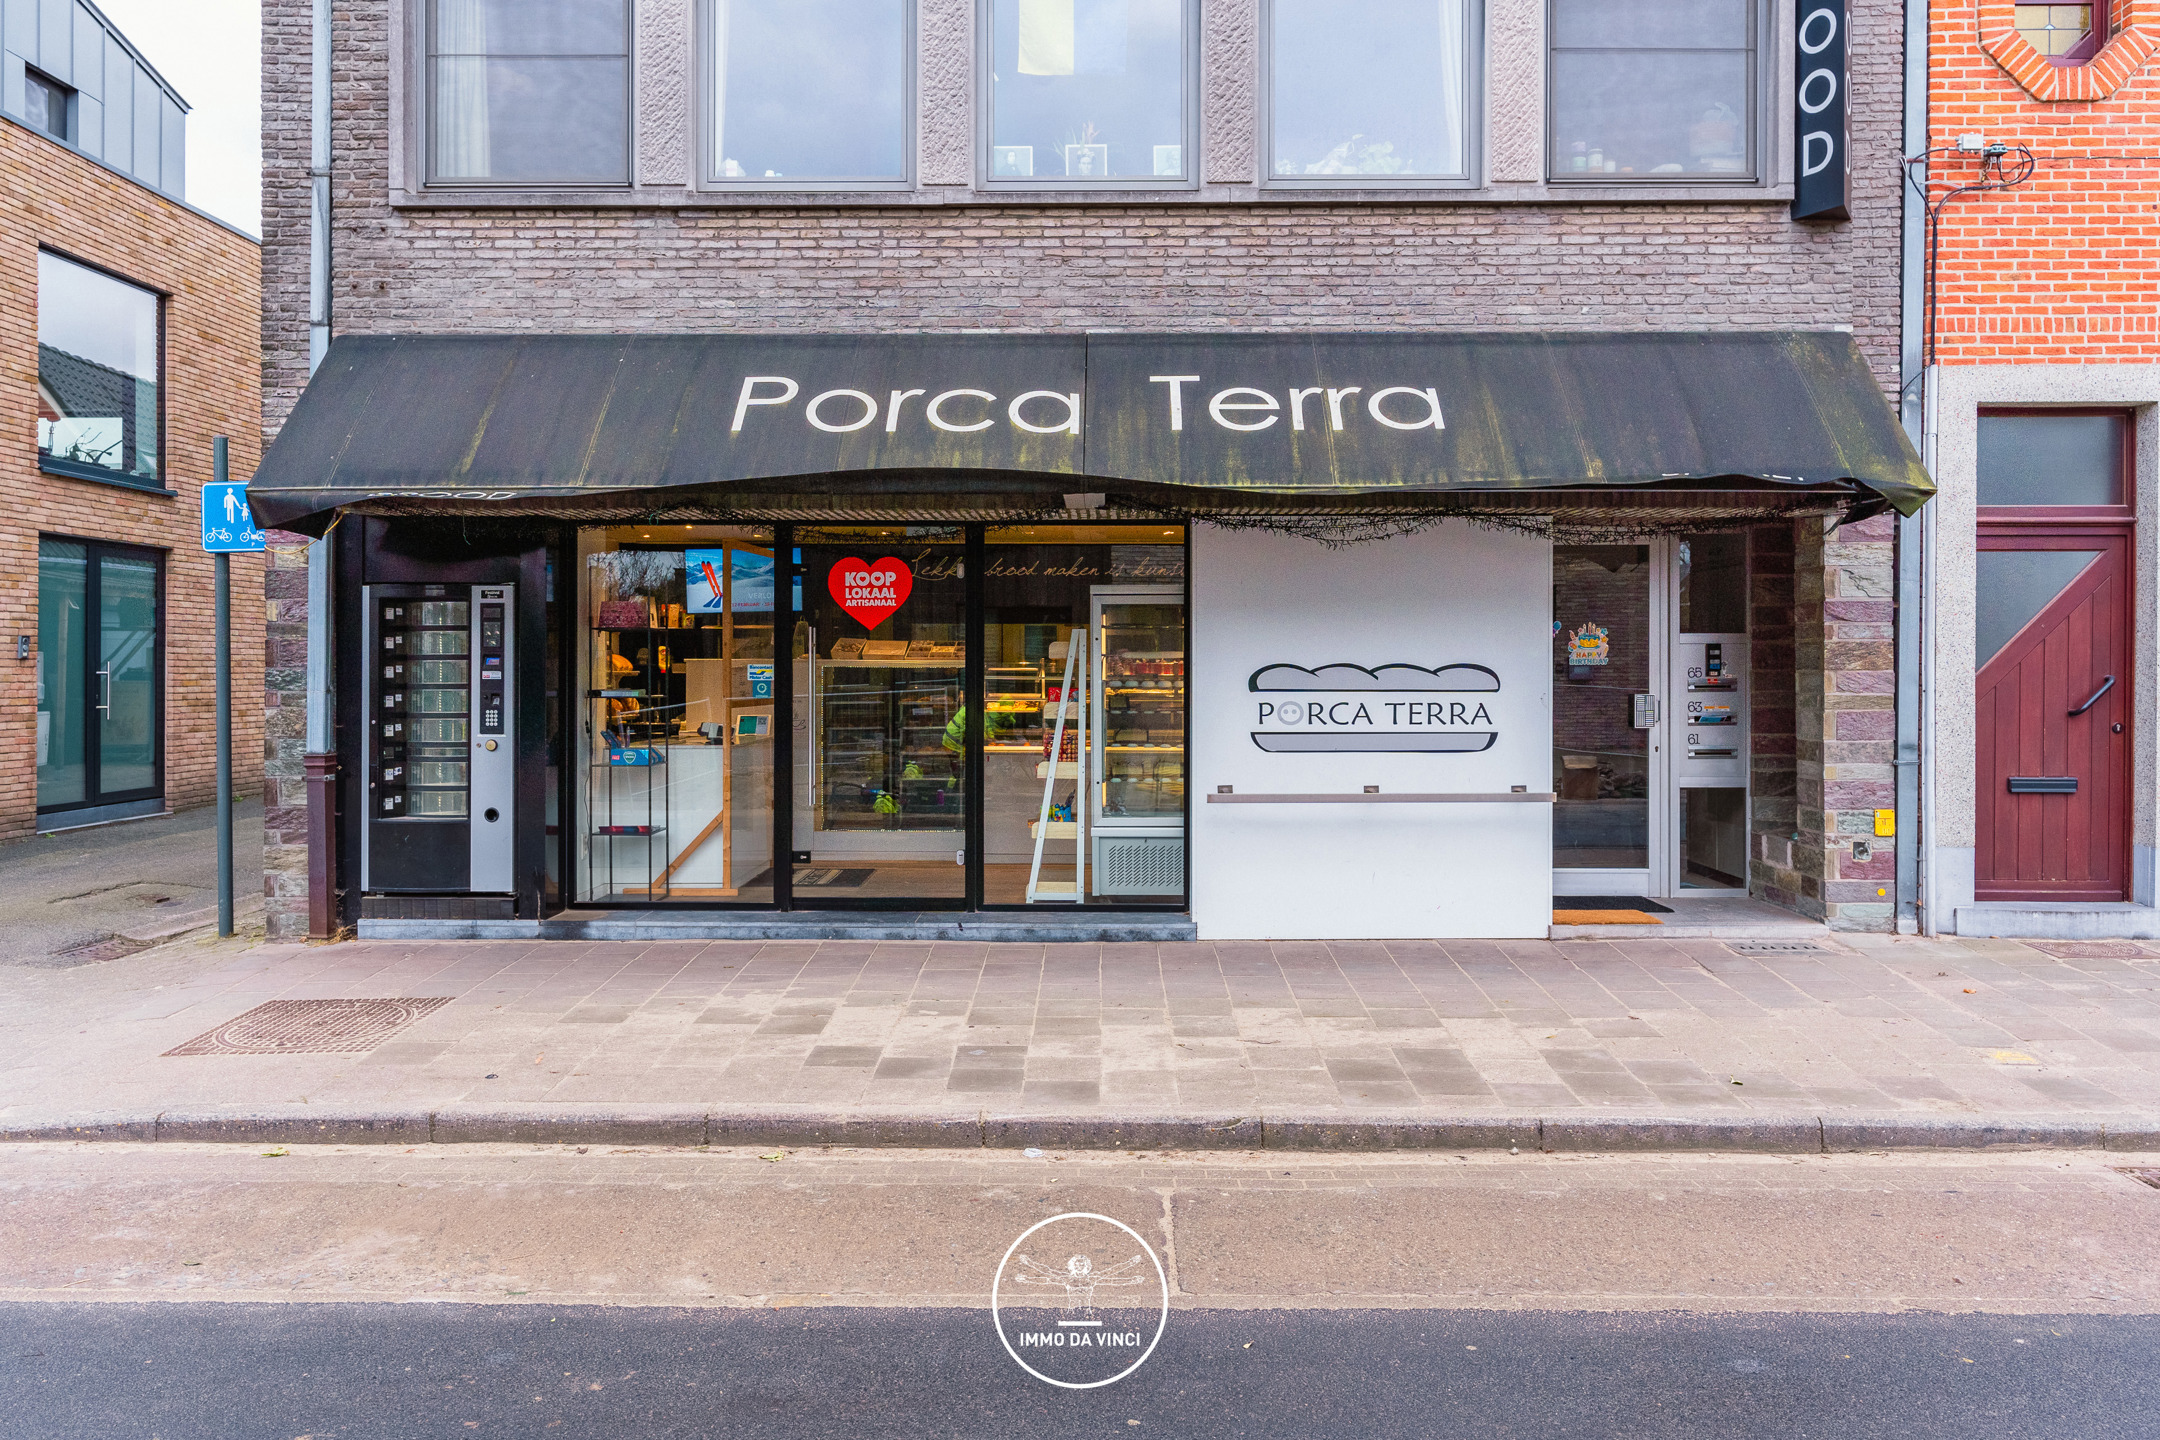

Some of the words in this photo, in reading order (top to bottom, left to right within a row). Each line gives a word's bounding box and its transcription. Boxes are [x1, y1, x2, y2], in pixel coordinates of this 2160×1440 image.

[731, 376, 1080, 434] Porca
[1150, 375, 1446, 431] Terra
[911, 548, 965, 581] Lekk
[984, 558, 1040, 576] brood
[1043, 556, 1100, 577] maken
[845, 571, 897, 586] KOOP
[845, 587, 896, 598] LOKAAL
[845, 599, 896, 607] ARTISANAAL
[1688, 667, 1702, 678] 65
[1688, 701, 1702, 712] 63
[1258, 701, 1374, 726] PORCA
[1385, 702, 1493, 726] TERRA
[1688, 734, 1700, 744] 61
